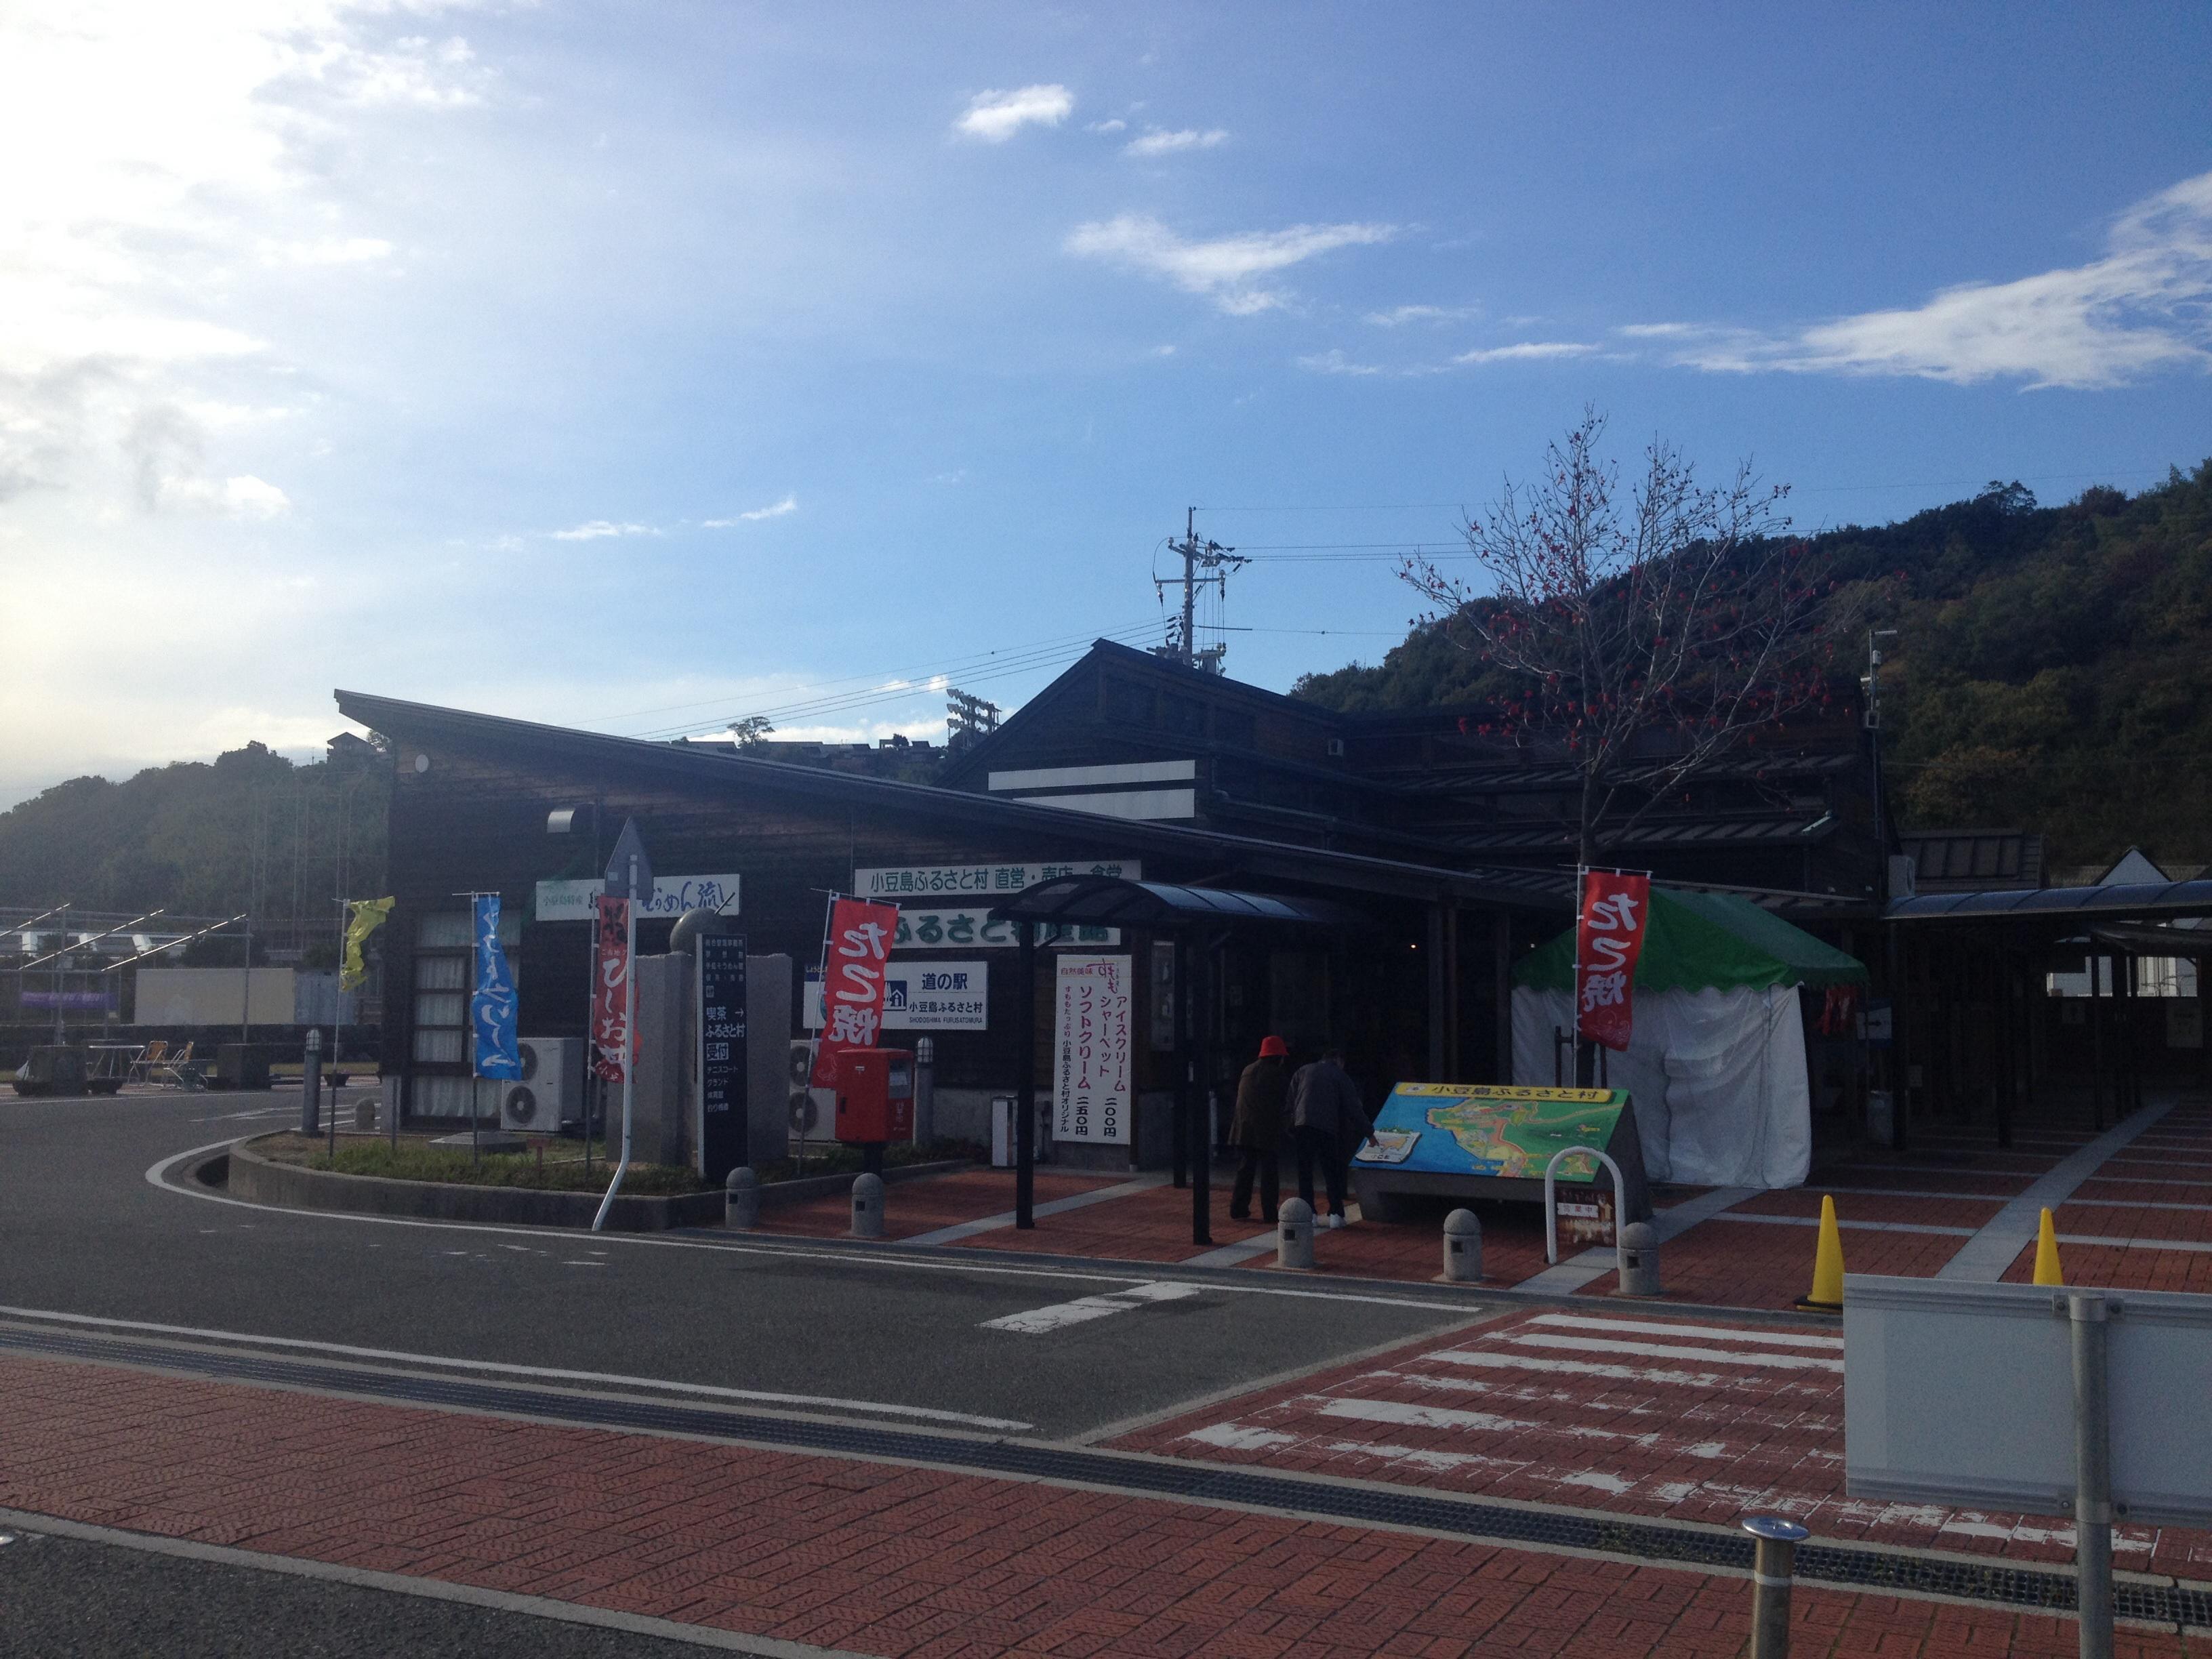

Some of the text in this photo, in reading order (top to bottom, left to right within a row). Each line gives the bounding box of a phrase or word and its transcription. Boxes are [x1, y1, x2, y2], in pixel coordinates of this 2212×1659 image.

[871, 868, 989, 893] 小豆島ふるさと村
[922, 972, 968, 990] 道の駅
[706, 1006, 727, 1021] 喫茶
[909, 1001, 983, 1014] 小豆島ふるさと村
[705, 1023, 745, 1038] ふるさと村
[1078, 985, 1092, 1090] ソフトクリーム
[1099, 996, 1112, 1078] シャーベット
[706, 1042, 729, 1061] 受付
[1115, 996, 1128, 1092] アイスクリーム
[1431, 1086, 1599, 1100] 小豆島ふるさと村
